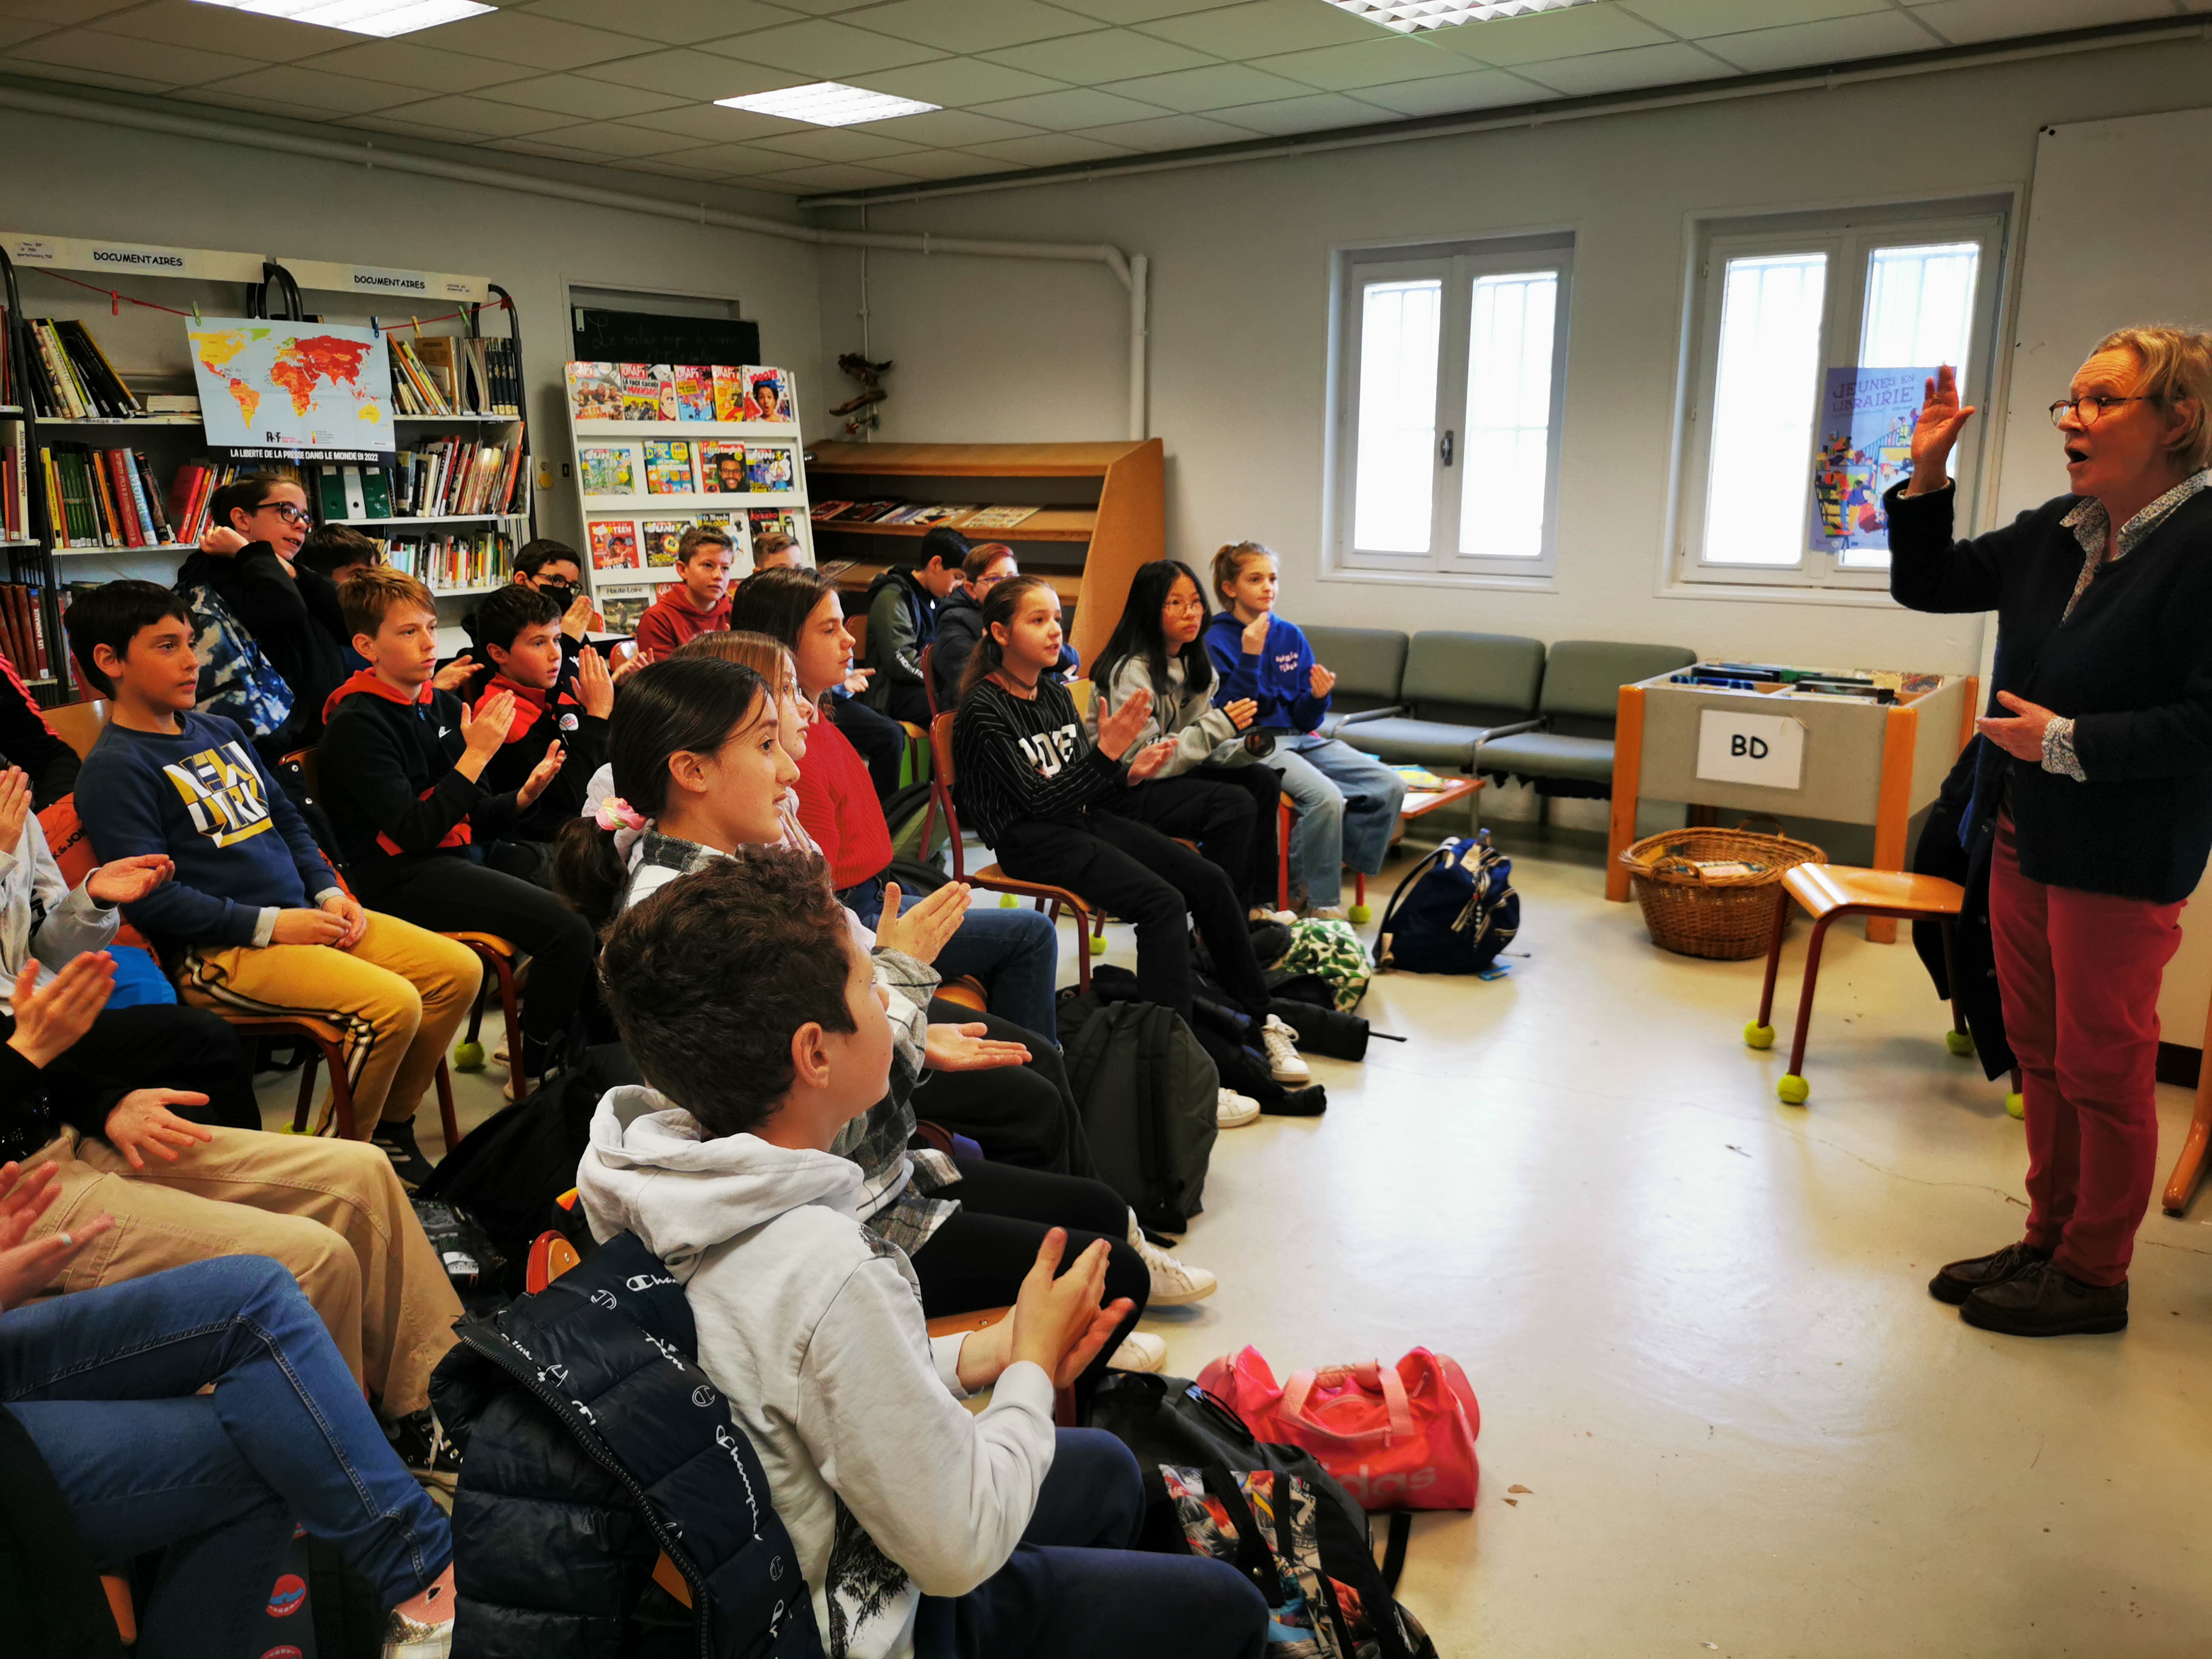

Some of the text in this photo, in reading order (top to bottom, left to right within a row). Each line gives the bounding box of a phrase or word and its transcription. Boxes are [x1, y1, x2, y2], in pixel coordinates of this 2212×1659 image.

[93, 251, 183, 266] DOCUMENTAIRES
[354, 275, 425, 289] DOCUMENTAIRES
[1832, 374, 1914, 398] JEUNES EN
[1832, 386, 1914, 412] LIBRAIRIE
[230, 449, 239, 457] LA
[240, 448, 263, 458] LIBERTÉ
[274, 450, 282, 458] LA
[283, 451, 304, 460] PRESSE
[305, 451, 324, 460] DANS
[324, 452, 333, 460] LE
[333, 452, 357, 460] MONDE
[364, 453, 378, 461] 2022
[33, 608, 44, 638] ANIMAUX
[1731, 734, 1768, 759] BD
